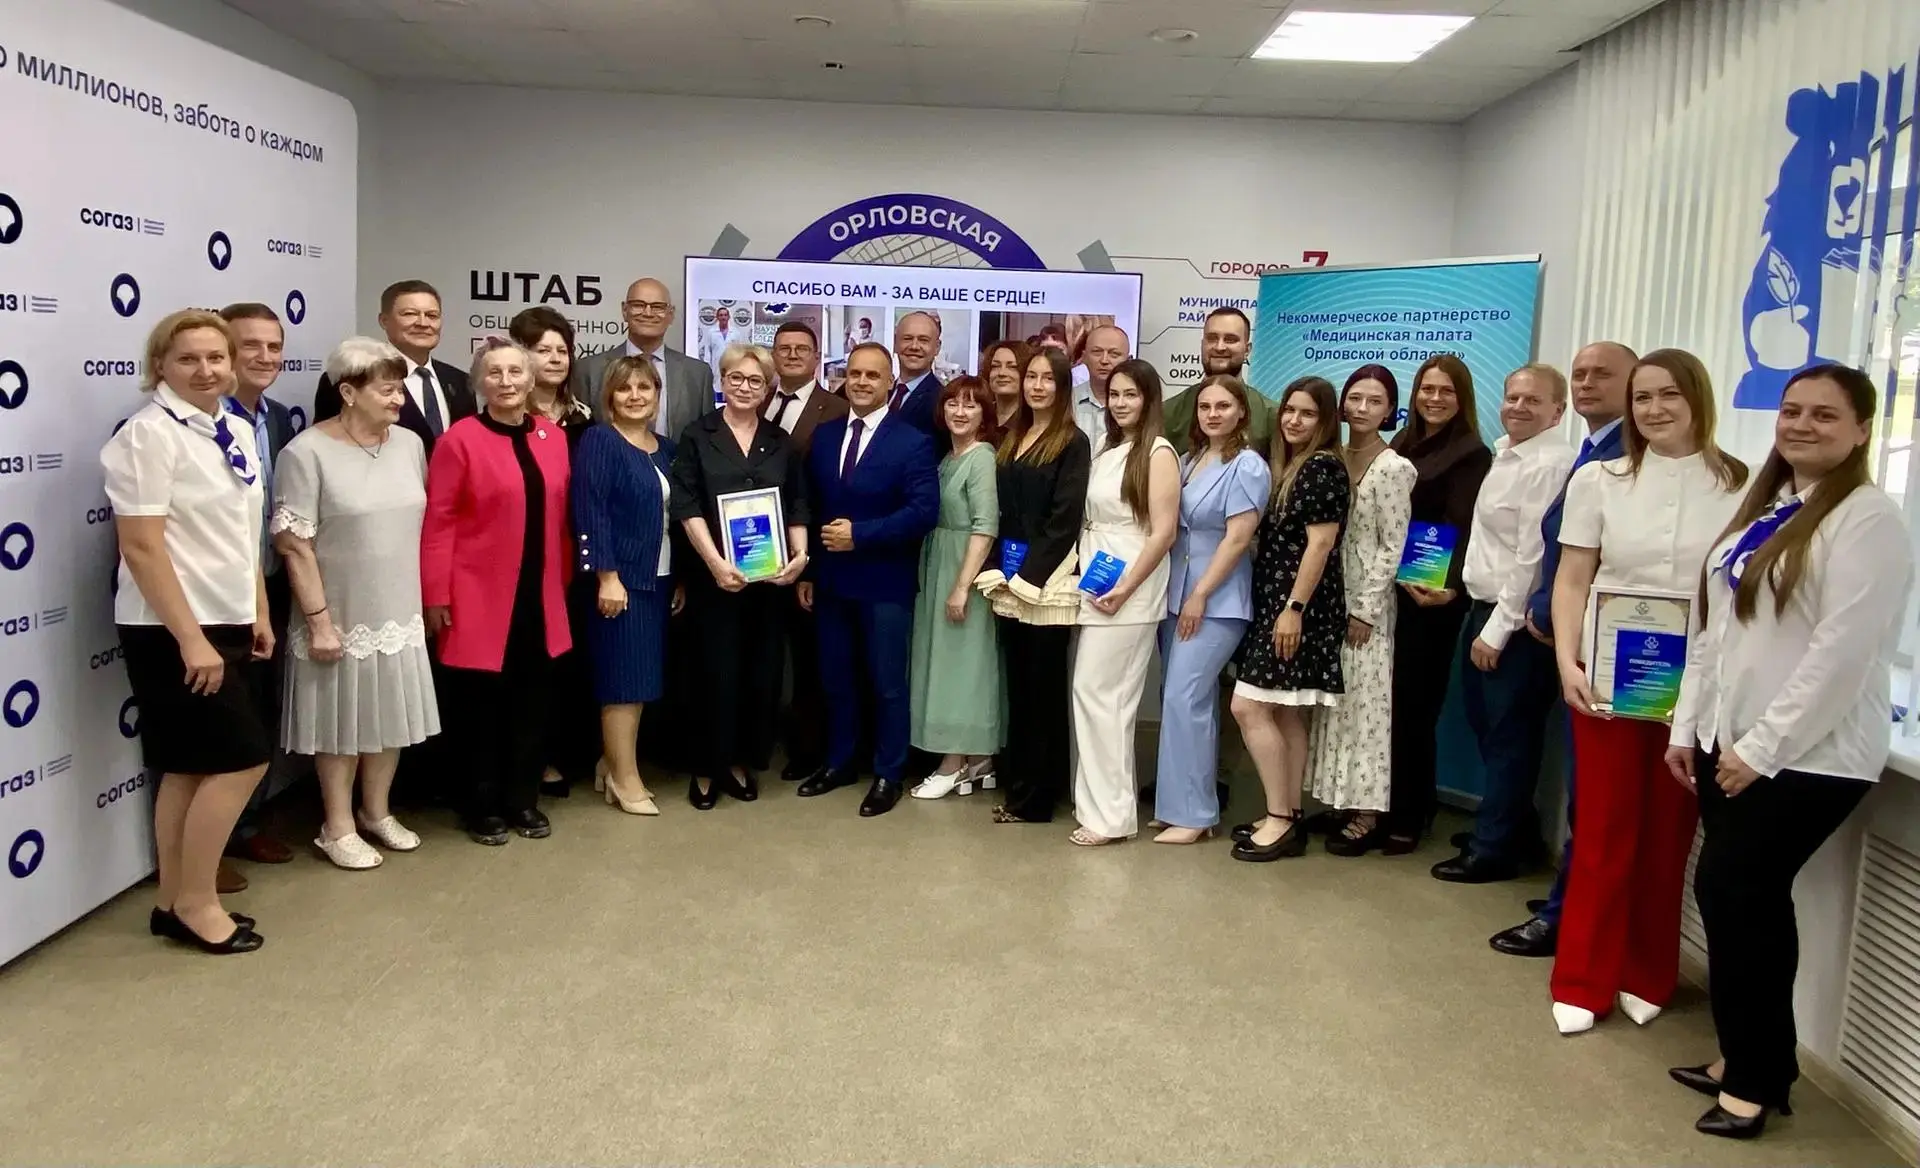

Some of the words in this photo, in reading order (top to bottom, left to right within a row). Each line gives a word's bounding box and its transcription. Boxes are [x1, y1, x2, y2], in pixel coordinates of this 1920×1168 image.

[17, 50, 168, 123] миллионов,
[174, 102, 240, 139] забота
[245, 125, 255, 143] о
[260, 128, 323, 163] каждом
[829, 205, 1002, 252] ОРЛОВСКАЯ
[470, 270, 602, 306] ШТАБ
[752, 280, 835, 297] СПАСИБО
[841, 284, 876, 298] ВАМ
[892, 286, 913, 299] ЗА
[919, 287, 968, 301] ВАШЕ
[973, 289, 1046, 306] СЕРДЦЕ!
[1180, 297, 1258, 309] МУНИЦИПА
[1277, 312, 1398, 326] Некоммерческое
[1303, 329, 1410, 343] «Медицинская
[1416, 330, 1472, 341] палата
[1304, 347, 1384, 362] Орловской
